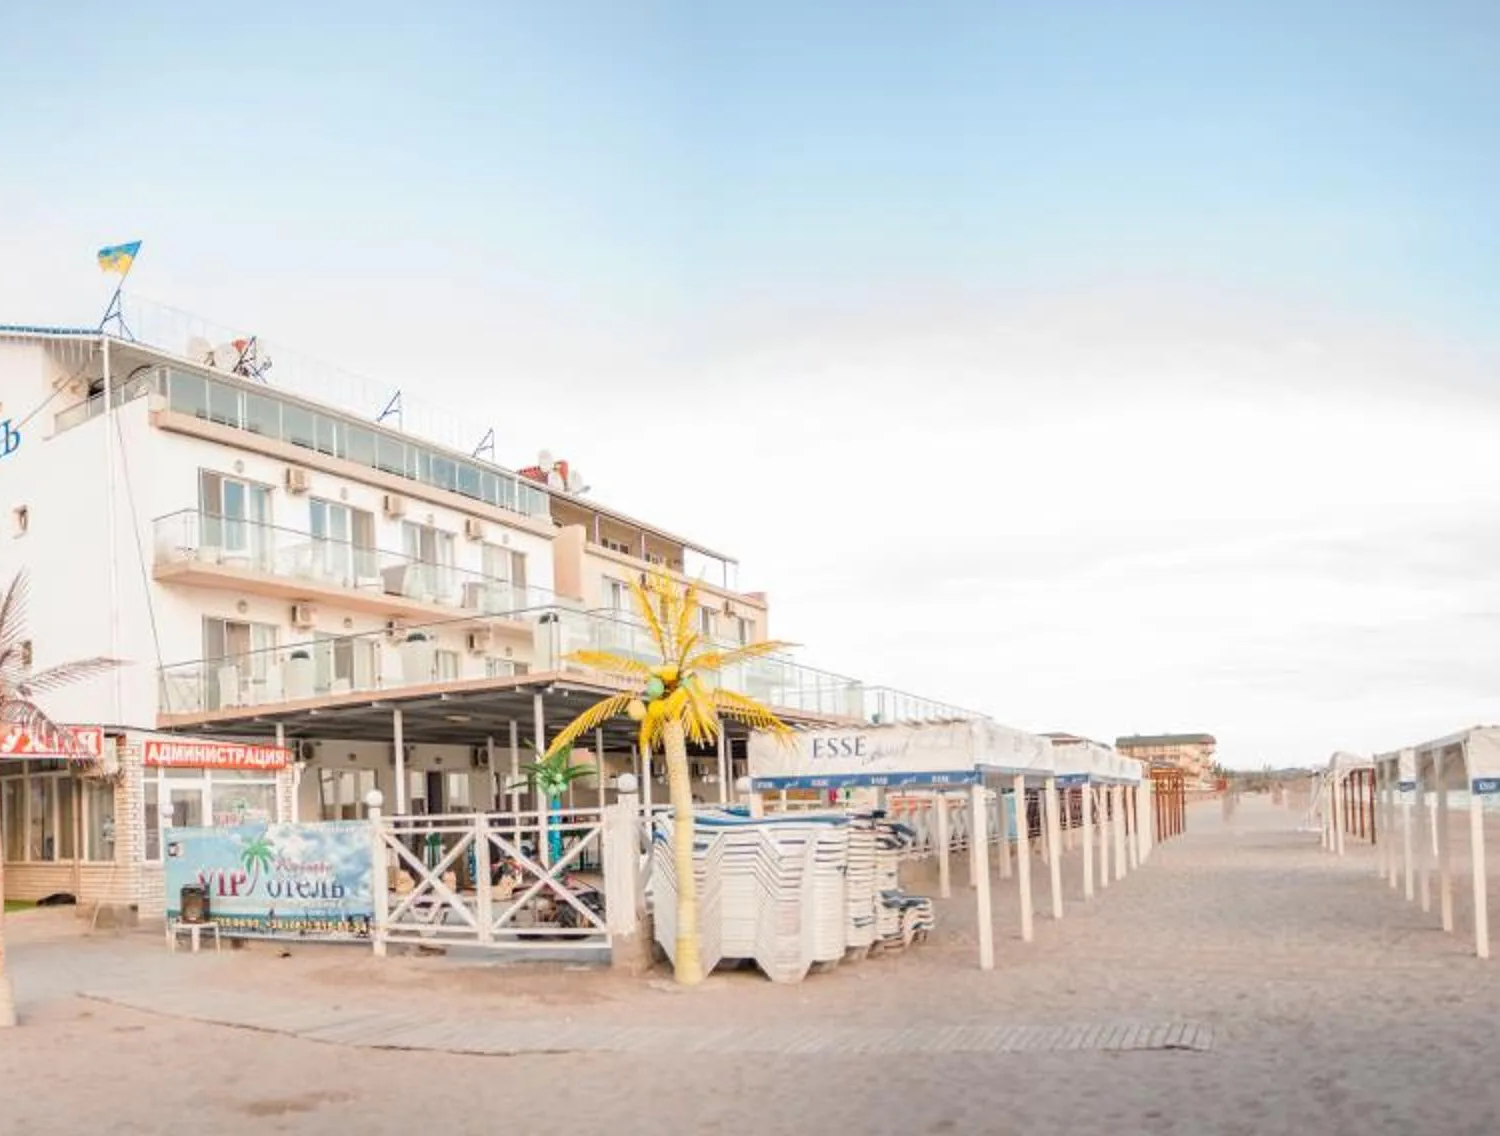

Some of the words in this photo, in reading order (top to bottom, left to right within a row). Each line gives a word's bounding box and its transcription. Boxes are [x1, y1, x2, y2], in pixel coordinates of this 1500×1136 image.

[147, 743, 286, 768] АДМИНИСТРАЦИЯ
[812, 736, 867, 759] ESSE
[198, 867, 246, 898] VIP
